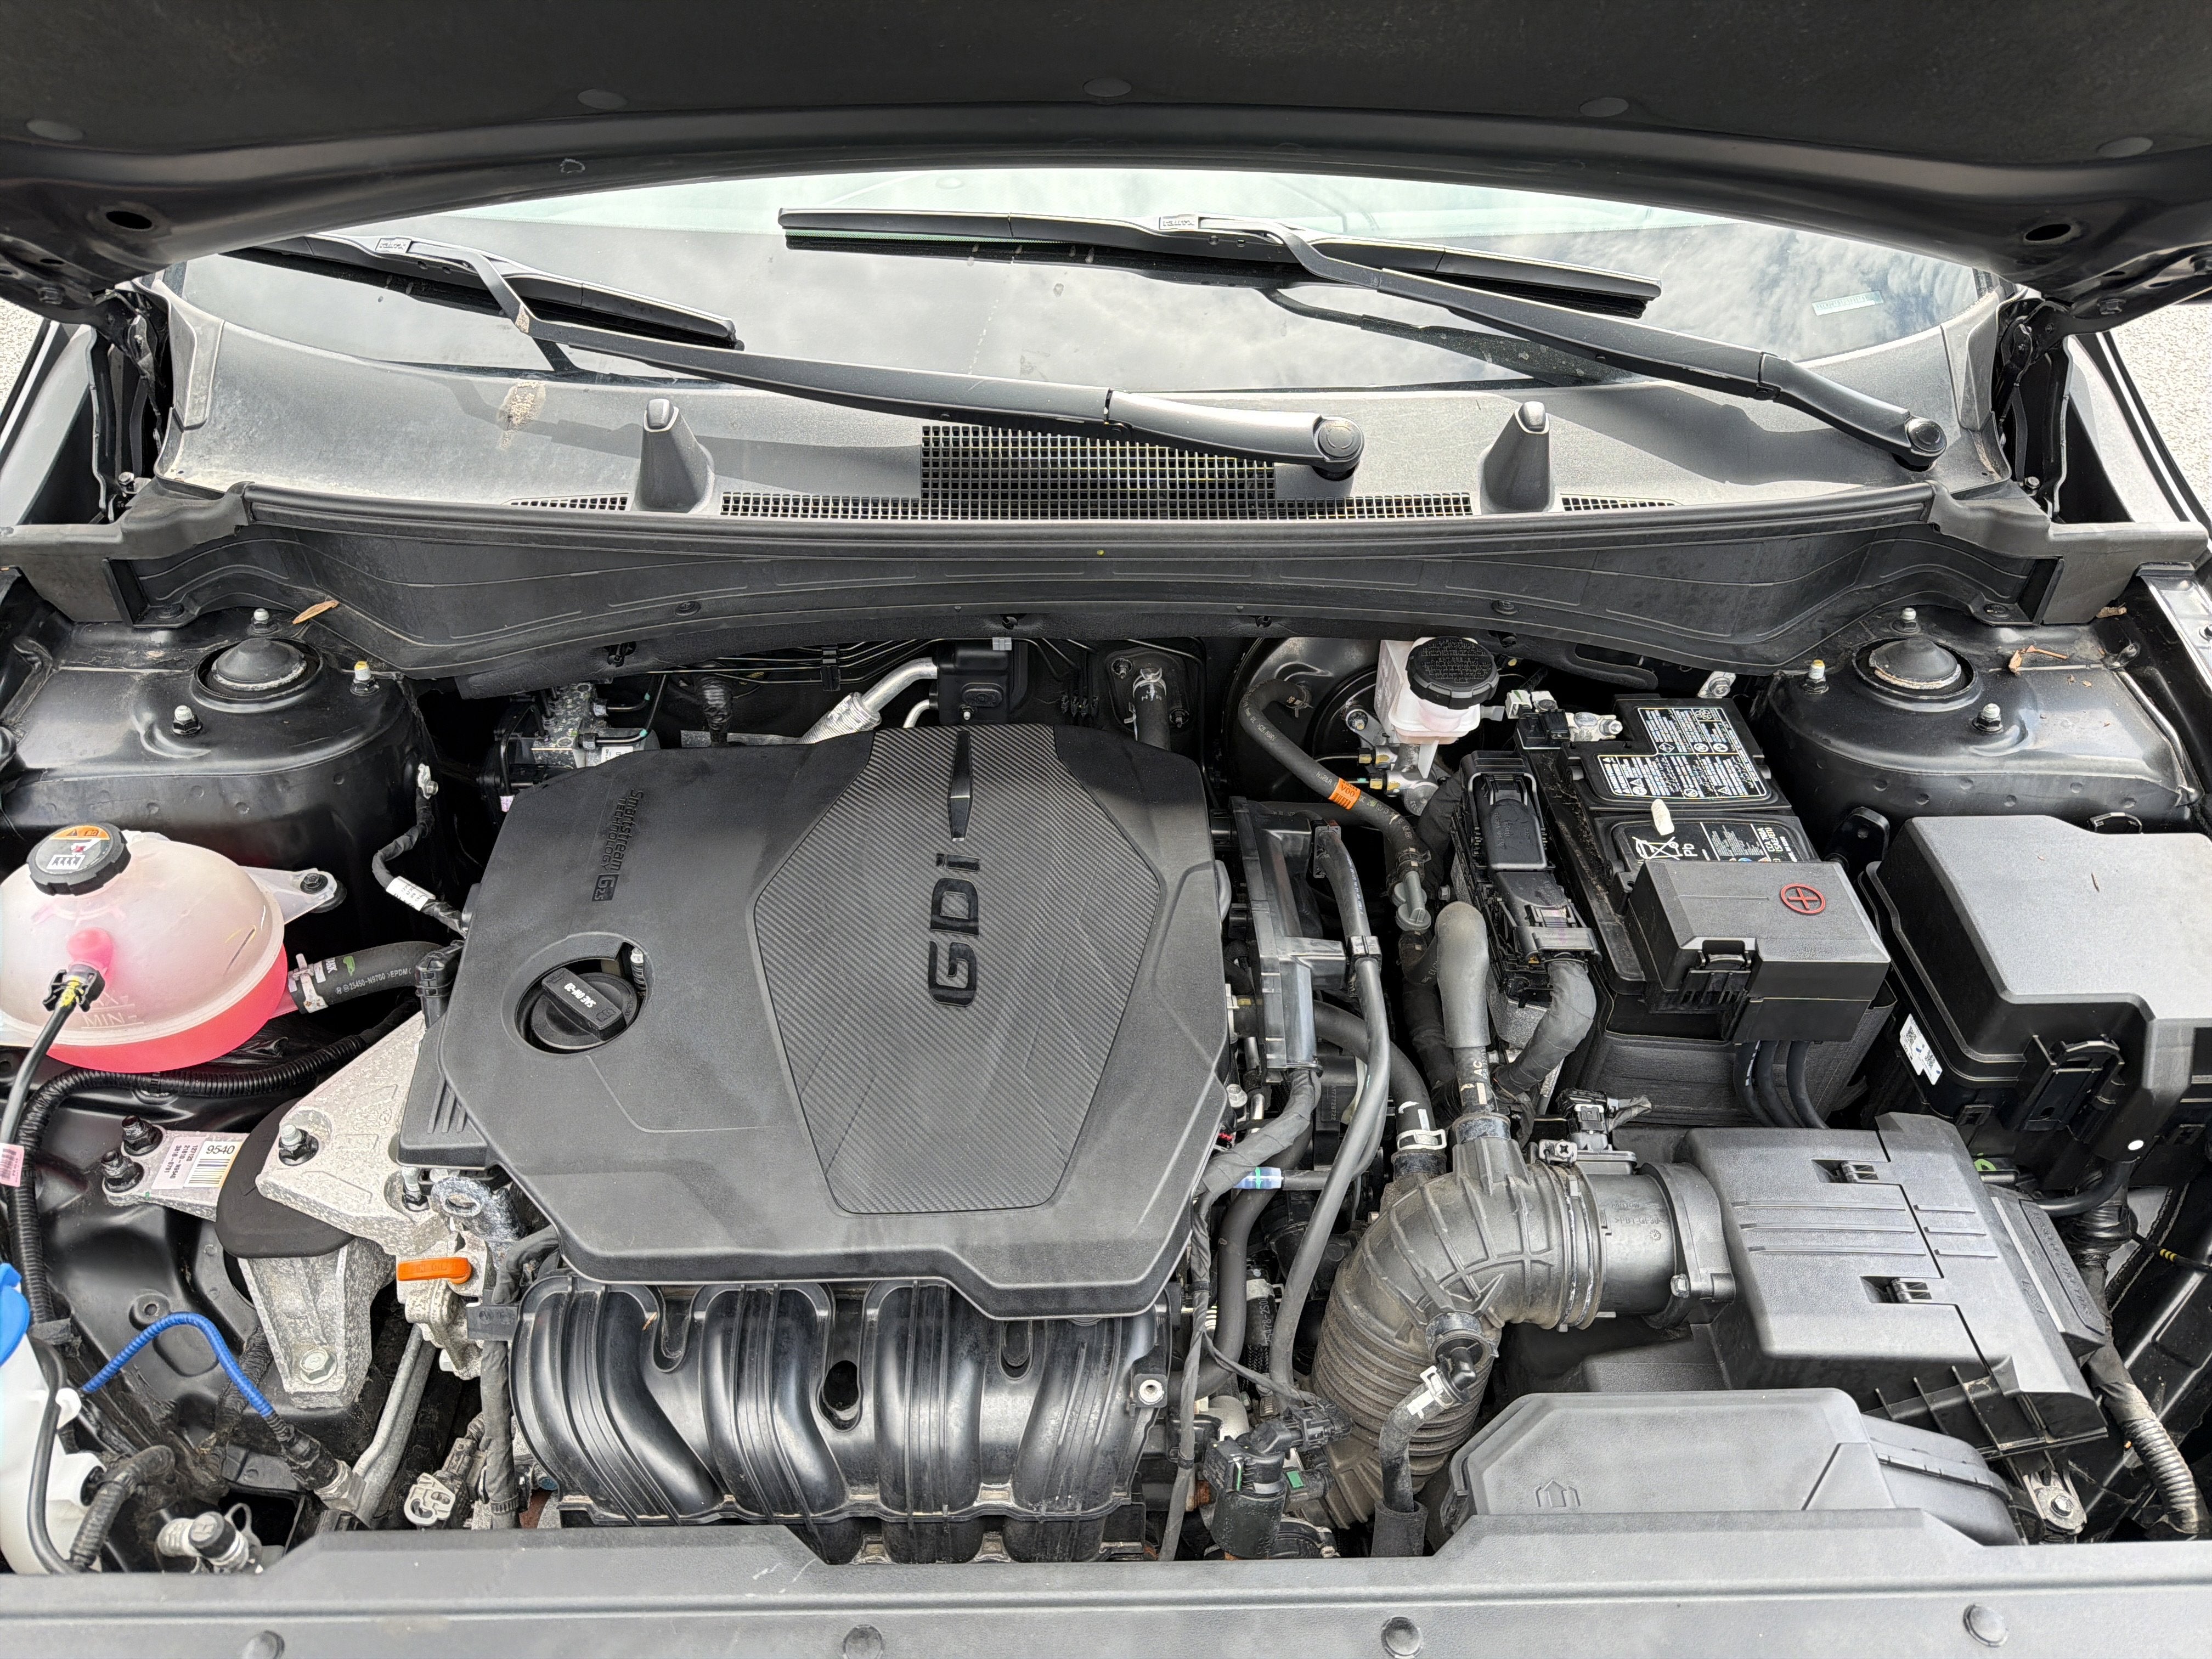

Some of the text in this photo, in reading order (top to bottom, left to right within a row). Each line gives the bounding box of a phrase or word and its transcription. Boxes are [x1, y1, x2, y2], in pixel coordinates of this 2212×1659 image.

[601, 797, 629, 871] TECHNOLOGY
[610, 787, 644, 872] Smartstream
[1682, 843, 1698, 857] Pb
[580, 996, 596, 1008] SAE
[82, 1012, 125, 1027] MIN
[1472, 1060, 1483, 1076] AC
[206, 1144, 235, 1155] 9540
